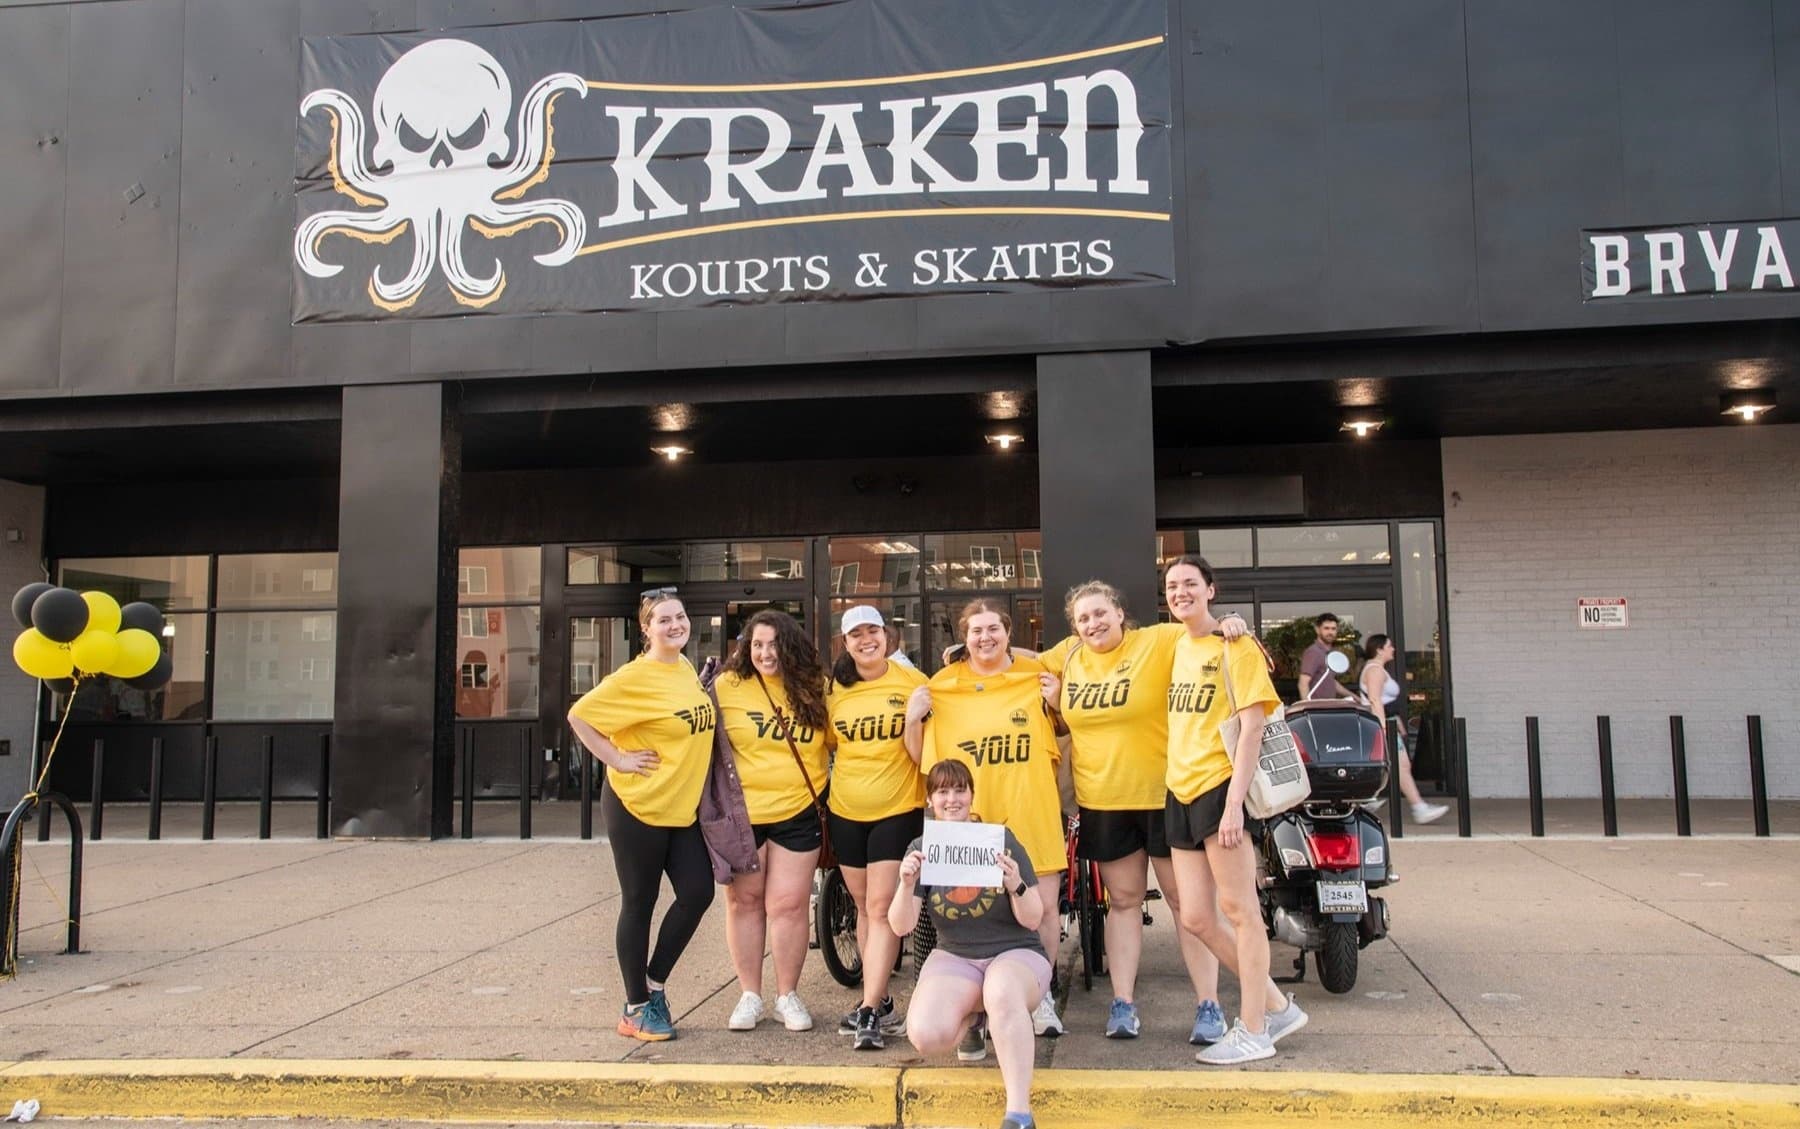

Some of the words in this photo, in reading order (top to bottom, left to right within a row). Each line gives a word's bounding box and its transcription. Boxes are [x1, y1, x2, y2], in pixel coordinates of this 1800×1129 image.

[599, 69, 1149, 228] KRAKEN
[630, 256, 832, 299] KOURTS
[854, 252, 888, 286] &
[912, 239, 1115, 282] SKATES
[1590, 226, 1795, 297] BRYA
[992, 564, 1015, 577] 514
[1584, 607, 1600, 622] NO
[1067, 678, 1130, 710] VOLO
[1168, 683, 1217, 713] VOLO
[673, 703, 714, 735] VOL
[834, 713, 906, 742] VOLO
[957, 733, 1031, 767] VOLO
[928, 844, 940, 863] GO
[944, 845, 995, 866] PICKELINAS
[1330, 891, 1353, 901] 2545
